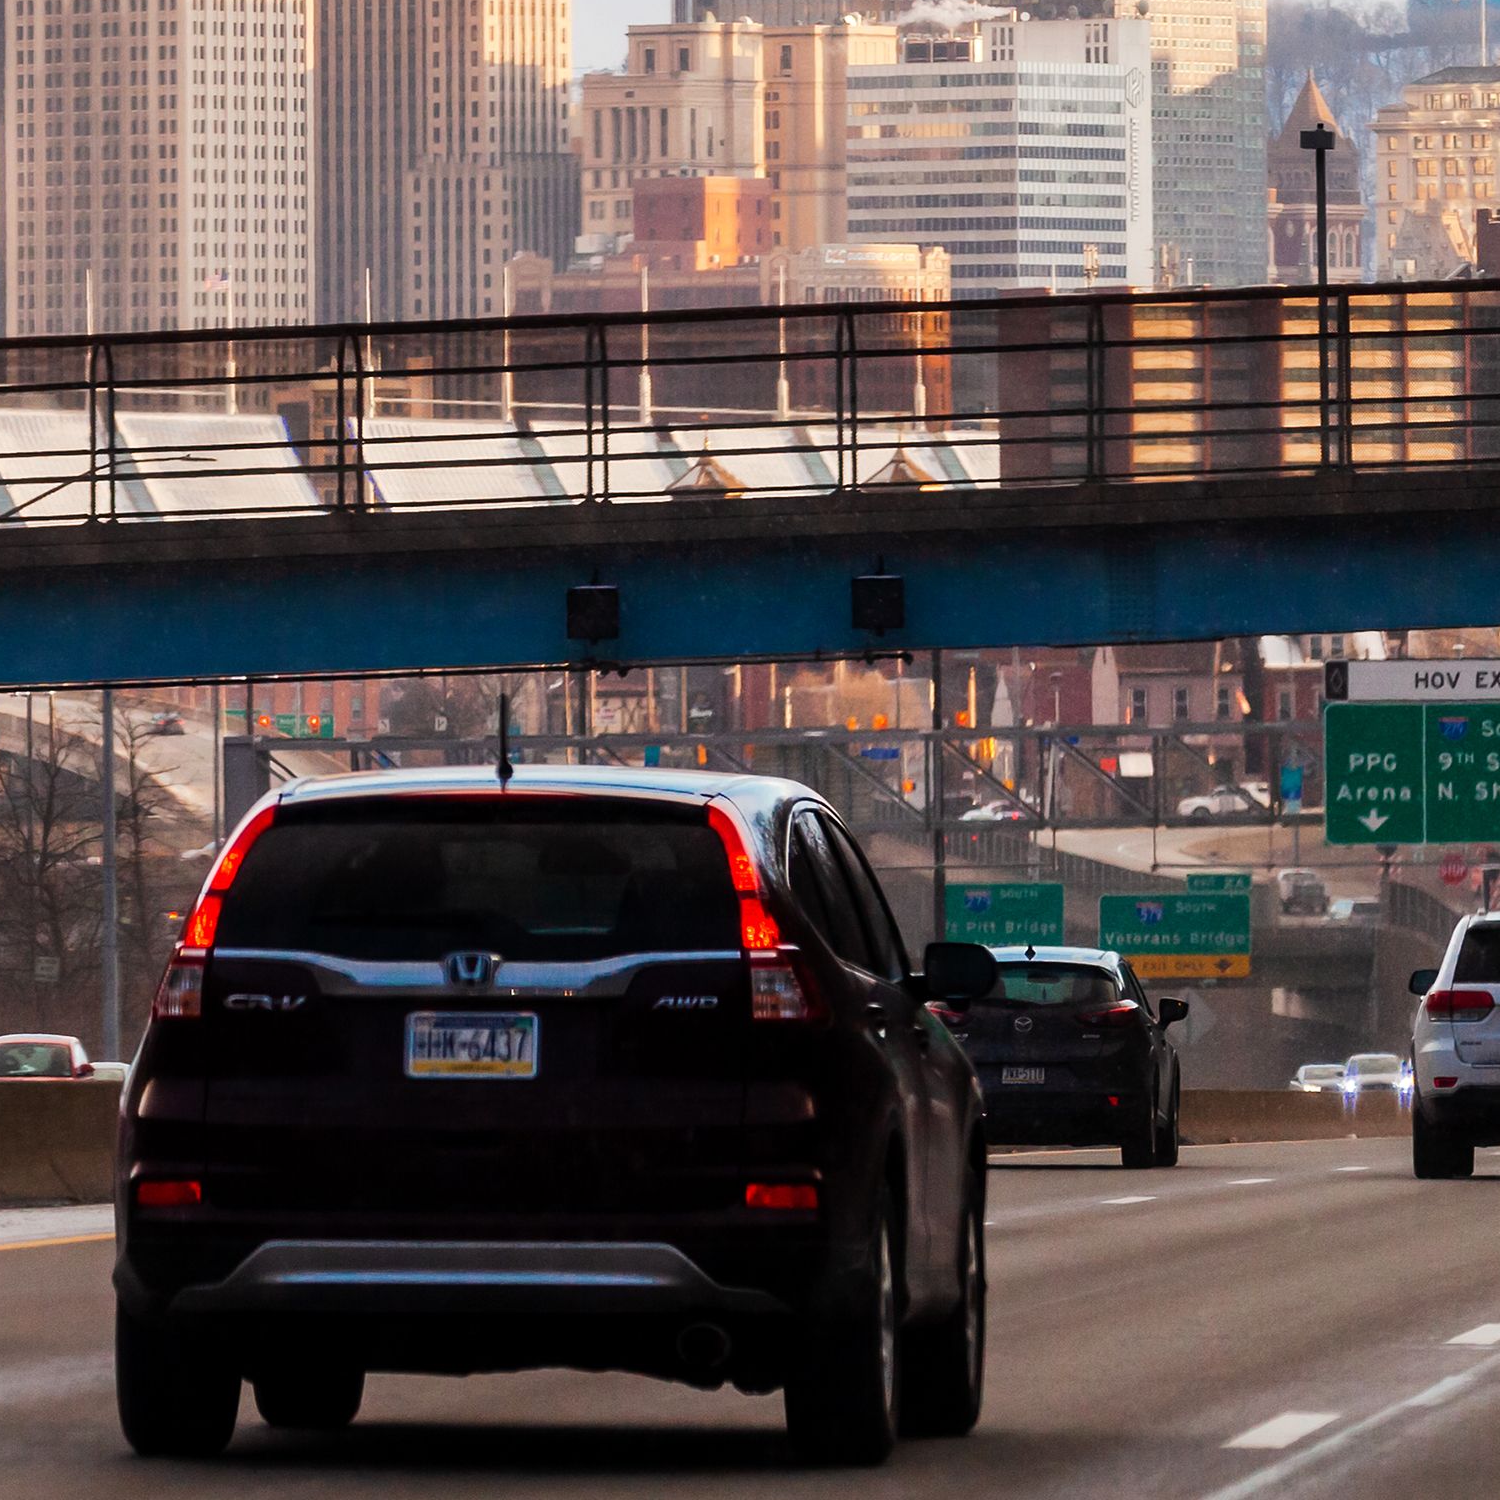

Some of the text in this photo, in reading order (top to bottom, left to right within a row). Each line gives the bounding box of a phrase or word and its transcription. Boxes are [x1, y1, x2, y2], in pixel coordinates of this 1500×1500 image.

[1415, 671, 1461, 689] HOV
[1349, 752, 1397, 772] PPG
[1337, 782, 1412, 801] Arena
[966, 921, 996, 933] Pitt
[1005, 920, 1057, 936] Bridge
[1105, 933, 1246, 947] Veterans Bridge
[652, 995, 718, 1010] AWD
